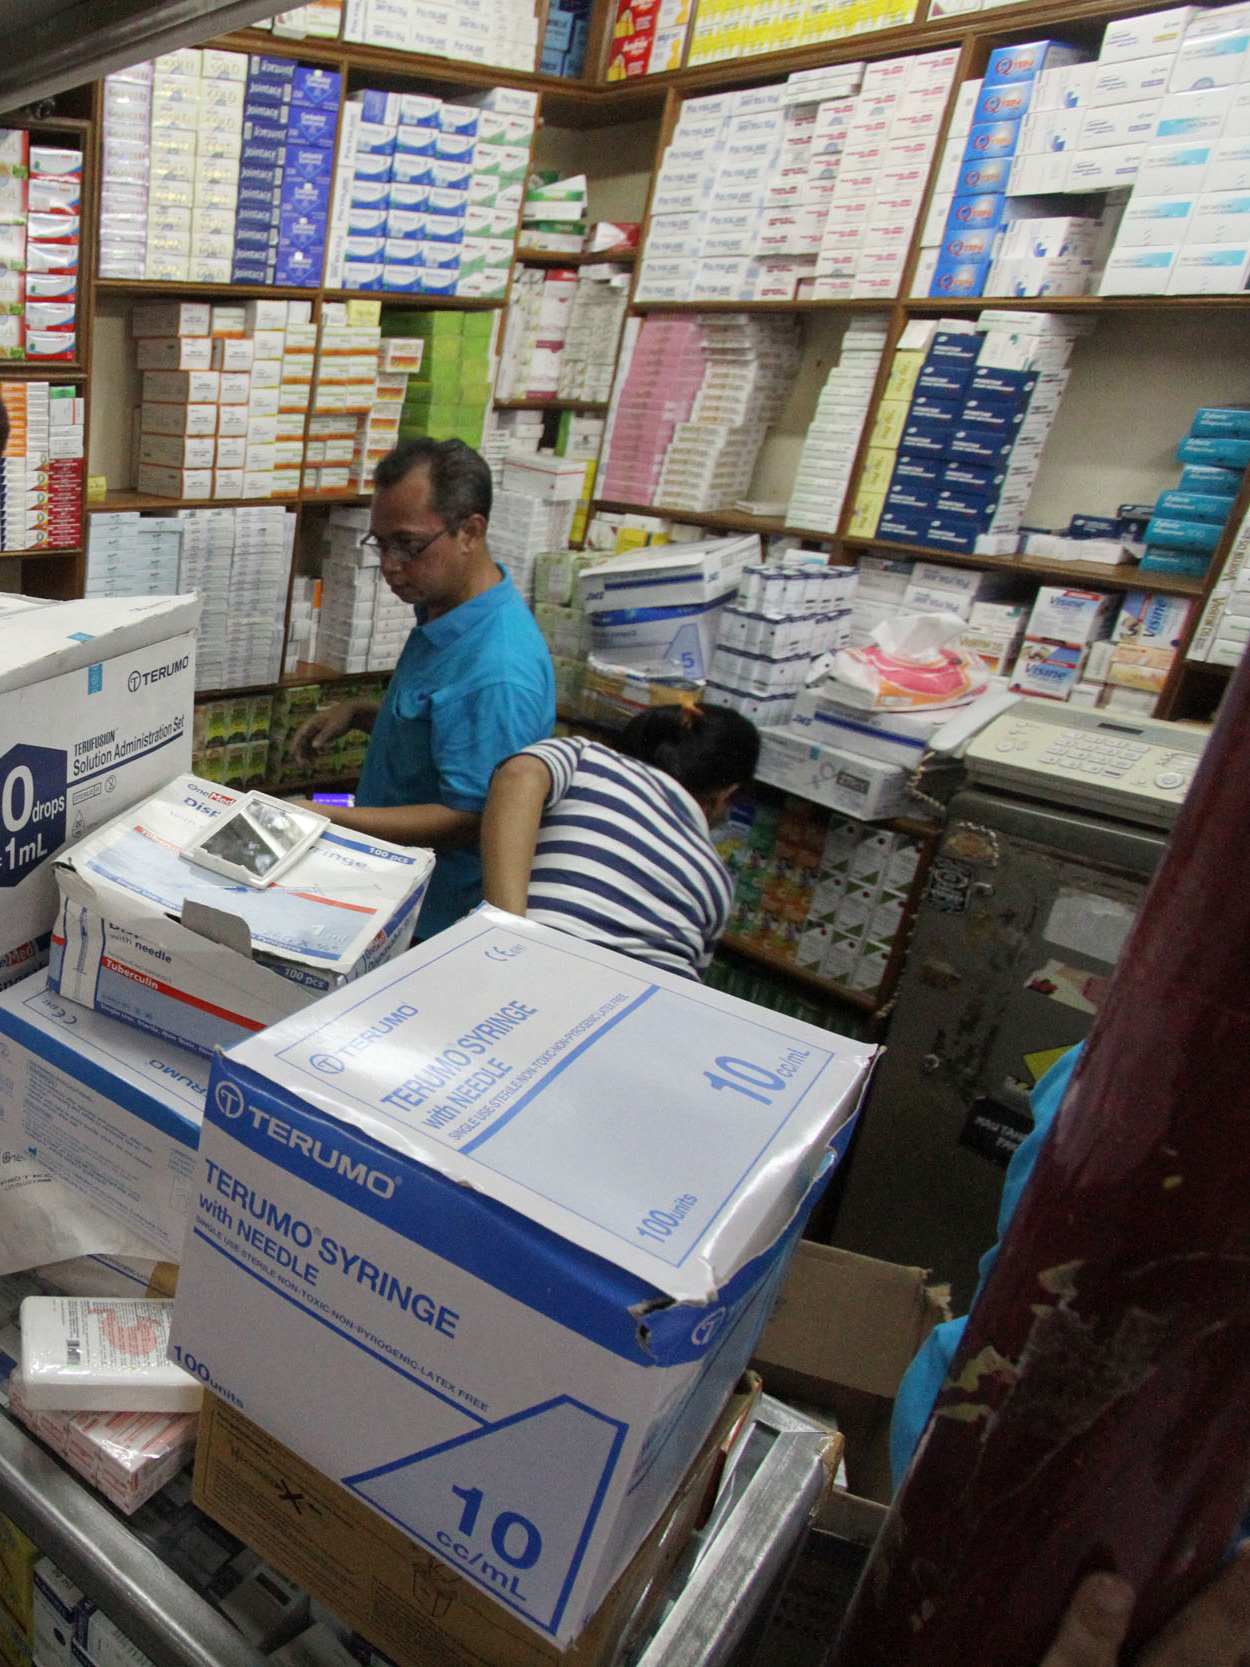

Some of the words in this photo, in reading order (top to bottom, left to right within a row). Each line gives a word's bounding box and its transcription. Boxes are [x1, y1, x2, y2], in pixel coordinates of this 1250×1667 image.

[1049, 594, 1085, 609] Visine
[1145, 600, 1167, 638] Visine
[142, 656, 190, 686] TERUMO
[681, 652, 695, 669] 5
[1024, 663, 1070, 681] Visine
[72, 743, 113, 777] Solution
[113, 723, 174, 759] Administration
[172, 714, 186, 731] Set
[73, 728, 116, 757] TERUFUSION
[31, 795, 65, 824] drops
[368, 847, 389, 859] 100
[389, 854, 410, 865] pcs
[109, 931, 133, 946] with
[134, 940, 173, 964] needle
[105, 957, 159, 991] Tuberculin
[283, 967, 304, 984] 100
[304, 976, 327, 989] pcs
[336, 1000, 419, 1063] TERUMO
[380, 1046, 472, 1114] TERUMO
[456, 1000, 539, 1057] SYRINGE
[421, 1100, 462, 1131] with
[445, 1056, 514, 1111] NEEDLE
[702, 1054, 788, 1107] 10
[774, 1047, 811, 1079] cc/mL
[448, 1115, 482, 1141] SINGLE
[248, 1105, 396, 1201] TERUMO
[199, 1193, 233, 1231] with
[236, 1219, 320, 1287] NEEDLE
[204, 1158, 313, 1248] TERUMO
[318, 1236, 461, 1340] SYRINGE
[196, 1213, 223, 1241] SINGLE
[457, 1385, 489, 1413] FREE
[451, 1485, 543, 1571] 10
[435, 1529, 528, 1603] cc/mL
